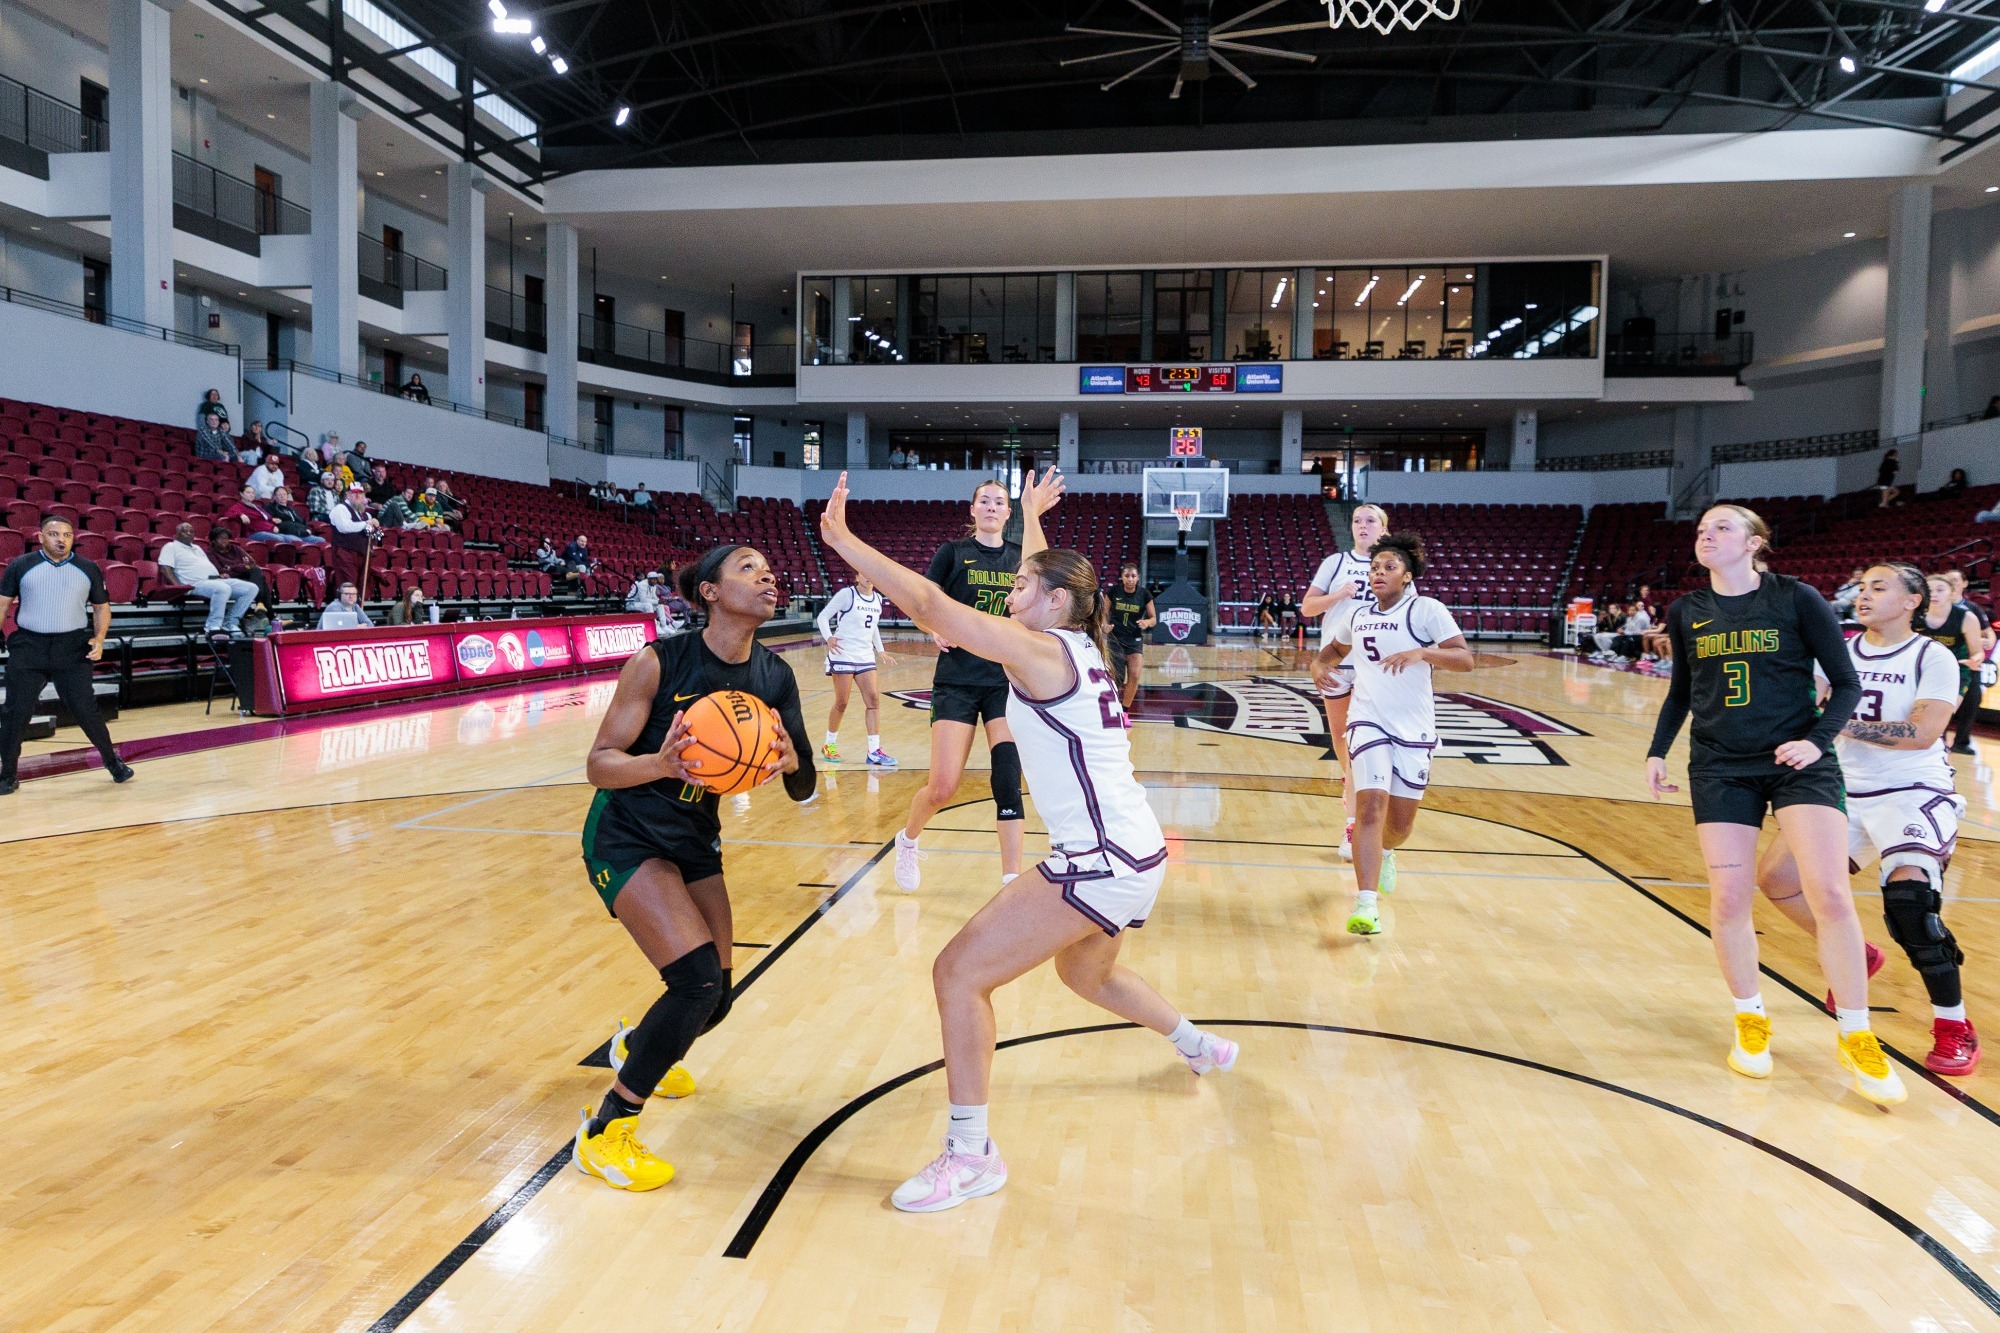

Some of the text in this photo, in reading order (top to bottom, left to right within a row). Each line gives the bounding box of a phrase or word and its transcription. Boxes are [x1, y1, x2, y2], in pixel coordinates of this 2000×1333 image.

[1136, 375, 1150, 386] 43
[1170, 368, 1198, 379] 2:57
[1213, 374, 1227, 386] 60
[1175, 439, 1197, 455] 26
[857, 605, 880, 613] EASTERN
[975, 589, 1009, 617] 20
[864, 614, 873, 629] 2
[1160, 610, 1201, 622] ROANOKE
[1354, 622, 1398, 633] EASTERN
[586, 626, 645, 656] MAROONS
[1363, 636, 1381, 662] 5
[1696, 629, 1779, 659] HOLLINS
[460, 643, 493, 661] ODAC
[316, 642, 432, 690] ROANOKE
[1723, 661, 1750, 707] 3
[1856, 671, 1906, 684] TERN
[1087, 667, 1124, 729] 2
[1851, 689, 1883, 721] 3
